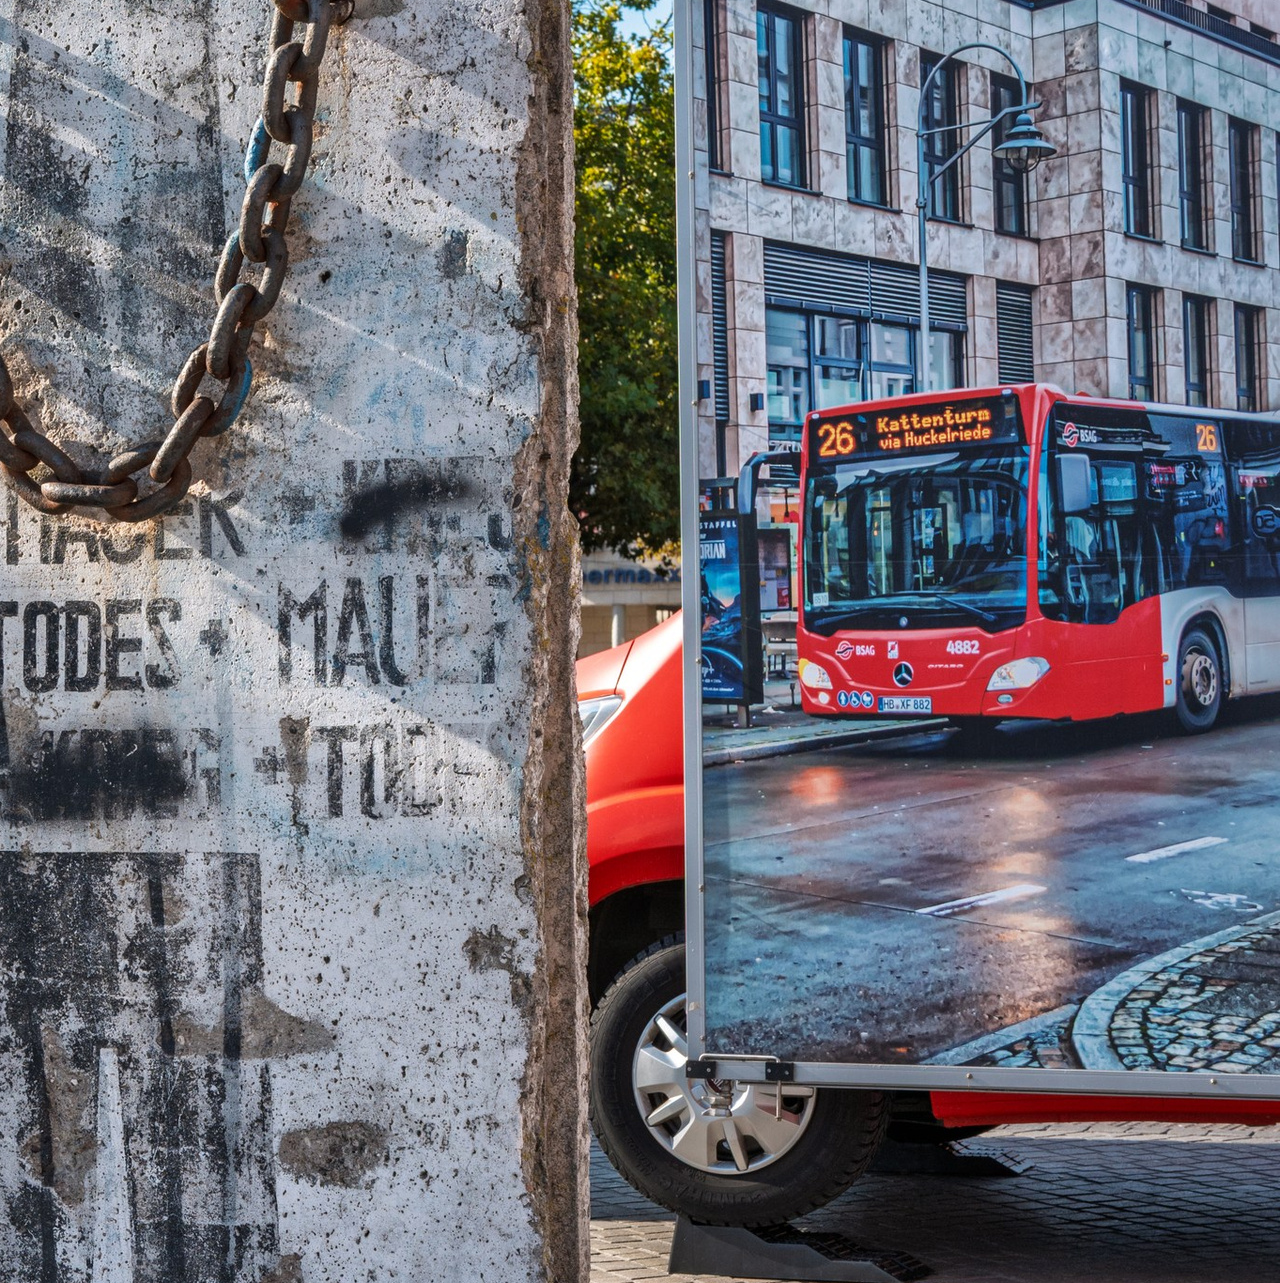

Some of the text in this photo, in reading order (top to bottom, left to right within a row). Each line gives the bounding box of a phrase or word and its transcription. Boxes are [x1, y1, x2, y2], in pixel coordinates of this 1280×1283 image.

[877, 407, 991, 434] Kattenturm
[818, 421, 856, 457] 26
[880, 424, 992, 450] via Huckelriede
[1080, 429, 1097, 443] BSAG
[1196, 424, 1217, 451] 26
[855, 645, 876, 656] BSAG
[946, 640, 980, 655] 4882
[883, 699, 930, 710] HB XF 882
